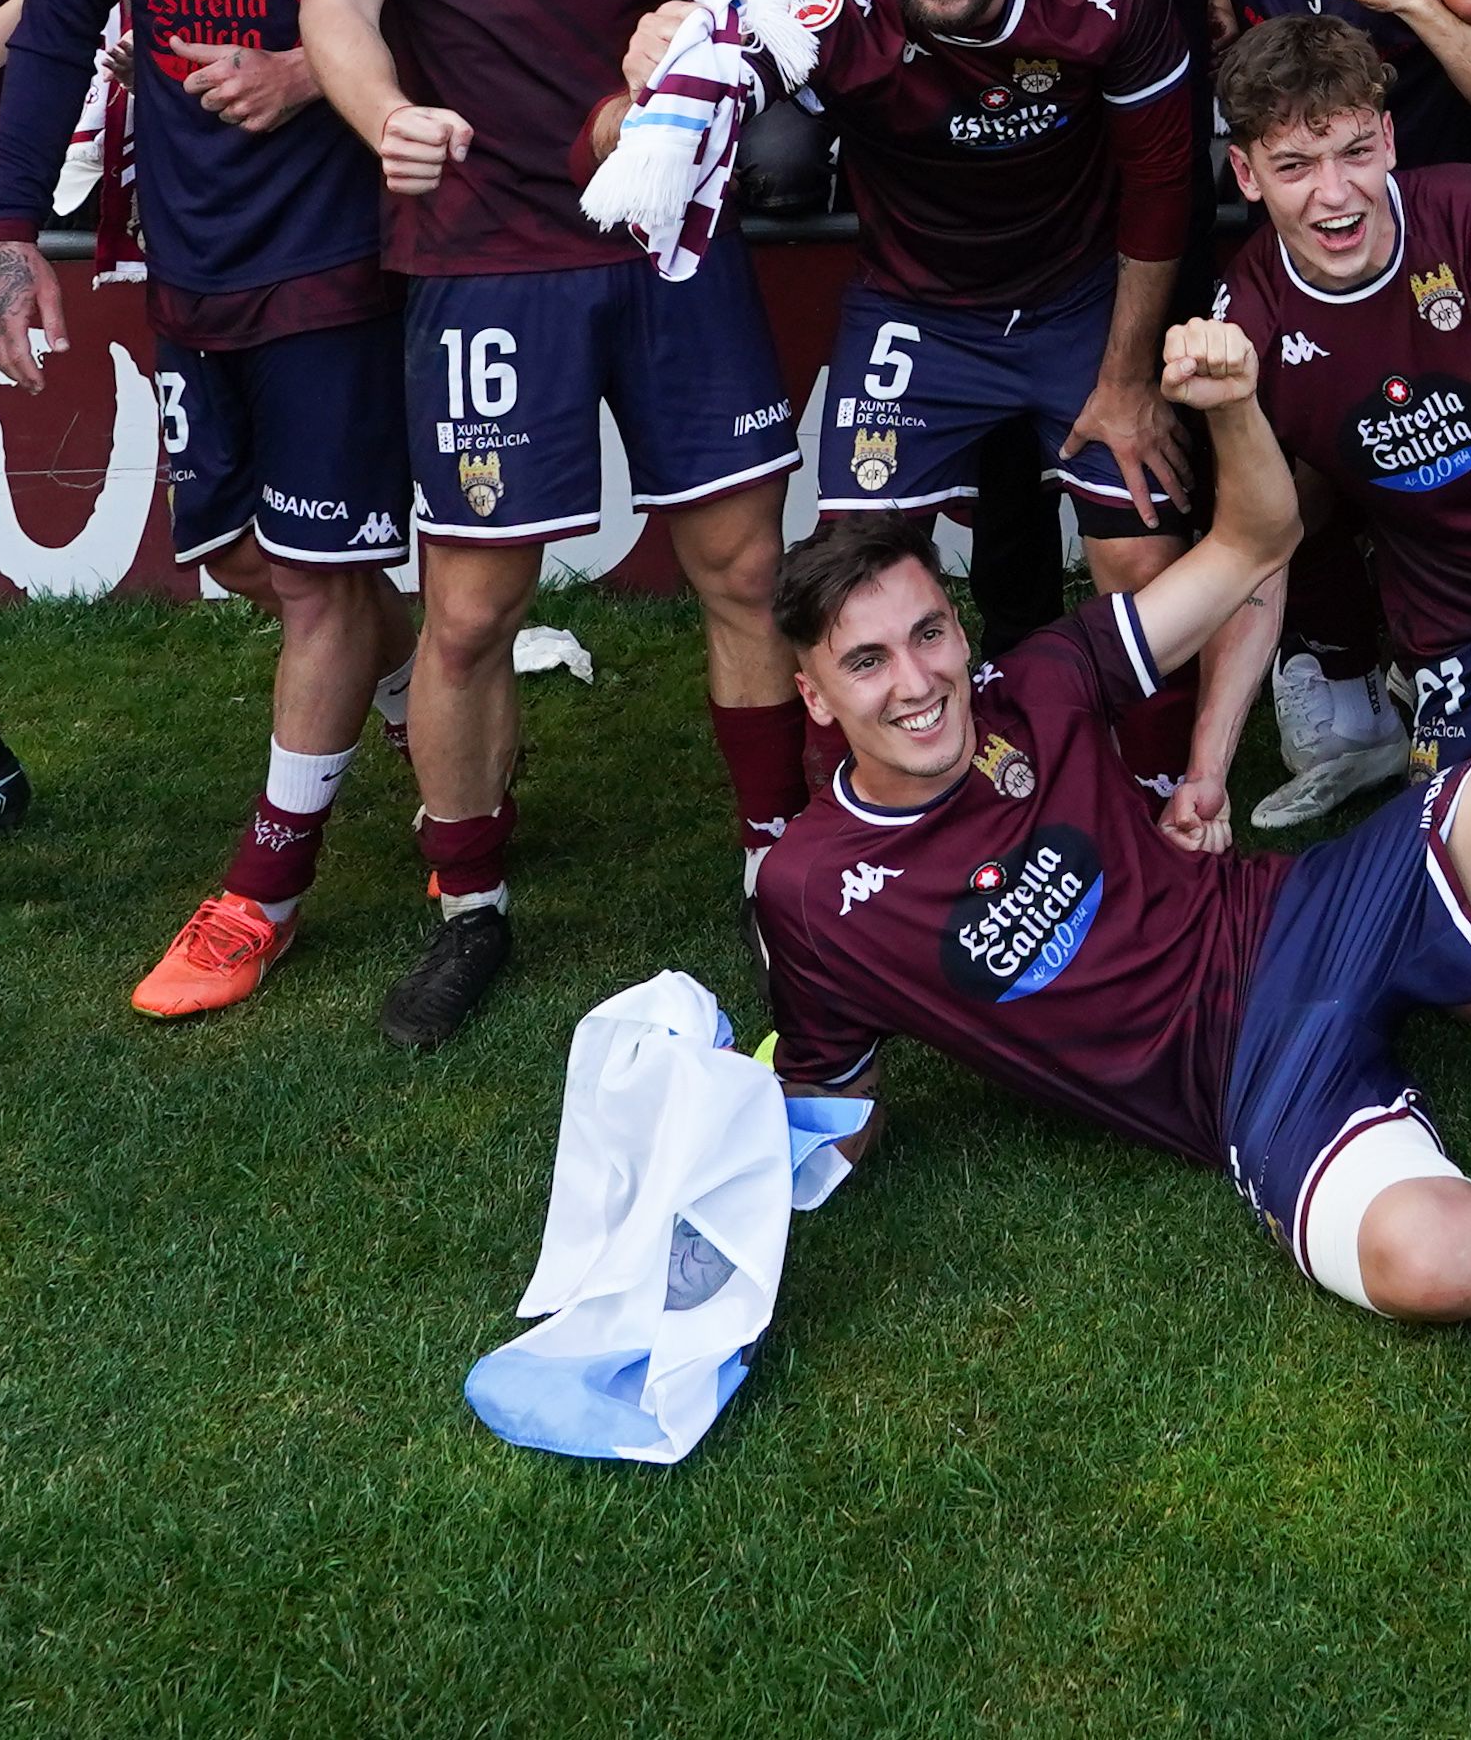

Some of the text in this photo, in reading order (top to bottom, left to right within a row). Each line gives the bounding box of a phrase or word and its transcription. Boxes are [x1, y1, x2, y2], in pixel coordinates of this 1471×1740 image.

[439, 327, 518, 420] 16
[864, 321, 920, 400] 5
[456, 421, 501, 436] XUNTA
[855, 413, 927, 429] DE GALICIA
[858, 400, 902, 415] XUNTA
[1358, 387, 1466, 449] Estrella
[456, 431, 531, 450] DE GALICIA
[1418, 455, 1454, 488] 0,0
[957, 843, 1063, 966] Estrella
[983, 870, 1083, 980] Galicia
[1042, 920, 1073, 969] 0,0
